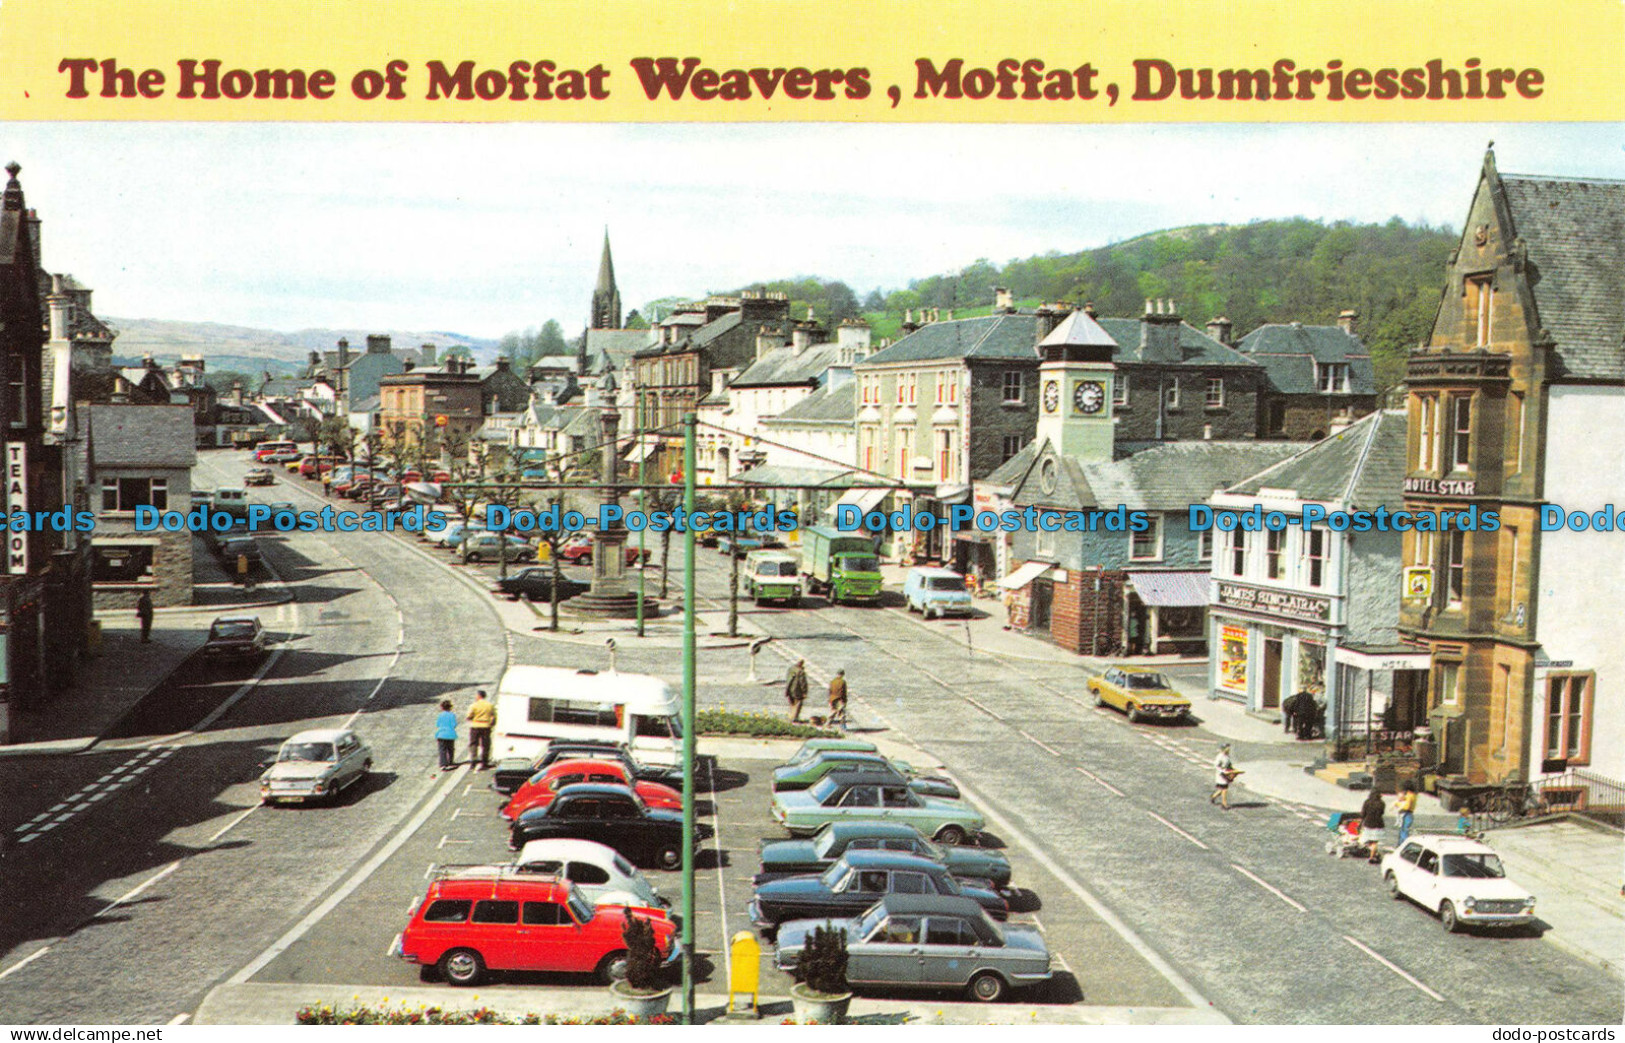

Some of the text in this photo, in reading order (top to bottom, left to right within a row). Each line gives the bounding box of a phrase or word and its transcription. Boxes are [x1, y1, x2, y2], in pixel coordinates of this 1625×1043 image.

[9, 447, 22, 494] TEA
[1405, 478, 1475, 495] HOTEL STAR
[1220, 585, 1256, 602] JAMES
